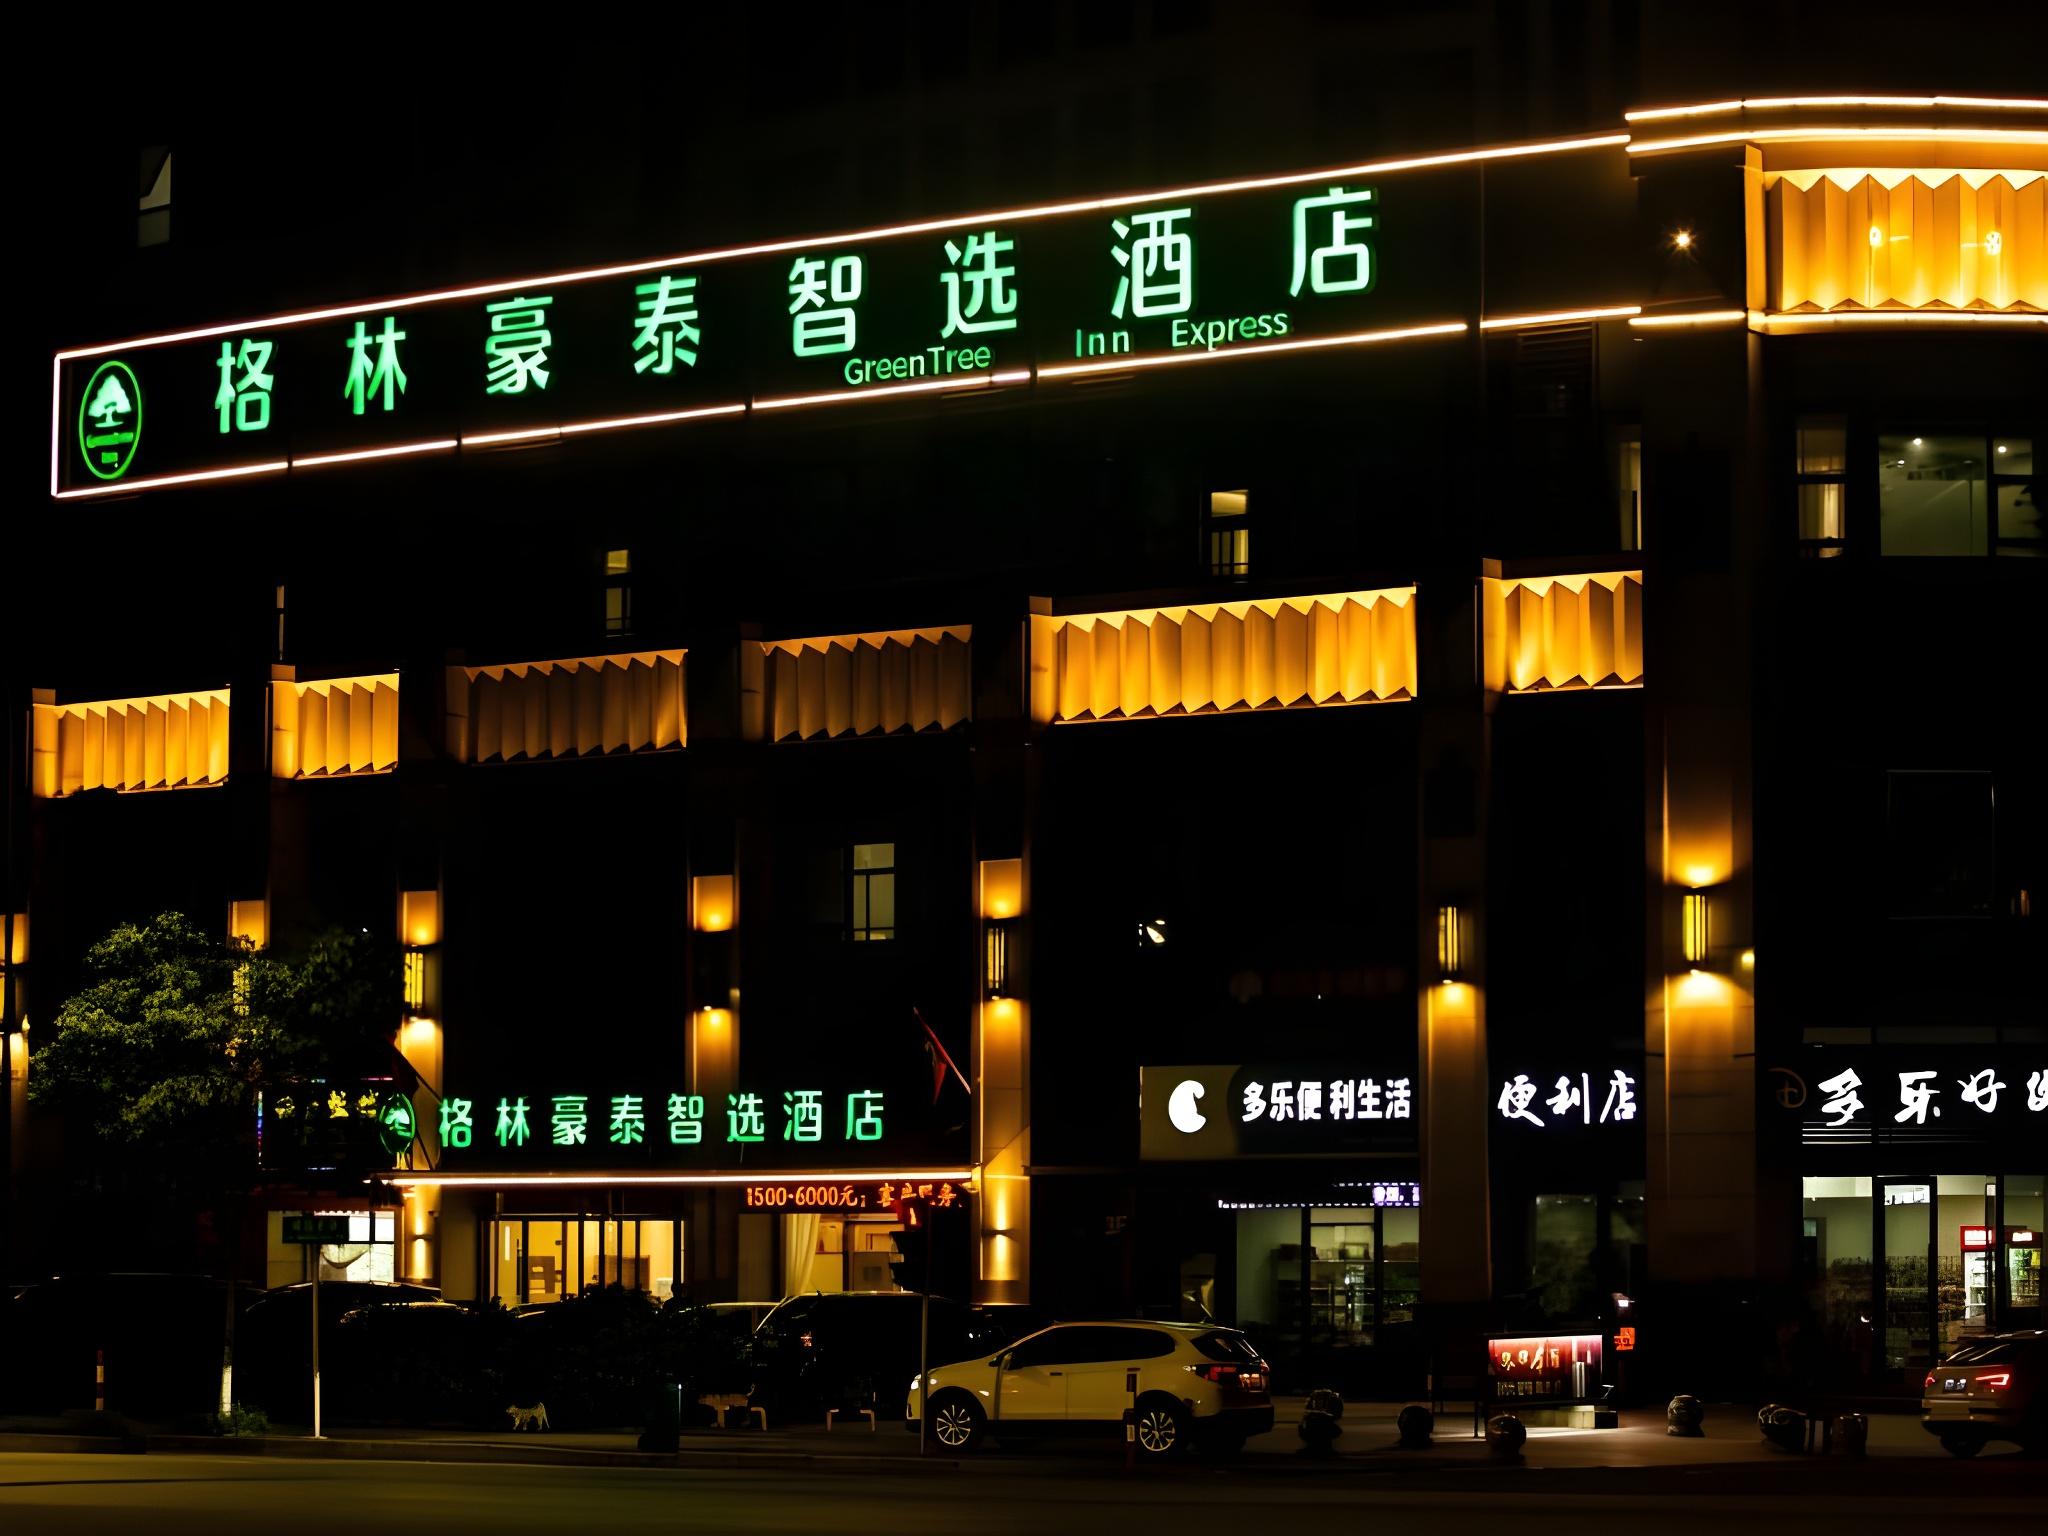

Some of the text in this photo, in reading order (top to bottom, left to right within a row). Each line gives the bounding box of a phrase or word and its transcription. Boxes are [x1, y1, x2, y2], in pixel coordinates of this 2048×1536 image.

[214, 186, 1374, 434] 格林豪泰智选酒店
[844, 311, 1290, 386] GreenTree Inn Express
[438, 1089, 885, 1148] 格林豪泰智选酒店
[1241, 1077, 1412, 1122] 多乐便利生活
[1497, 1069, 1637, 1127] 便利店
